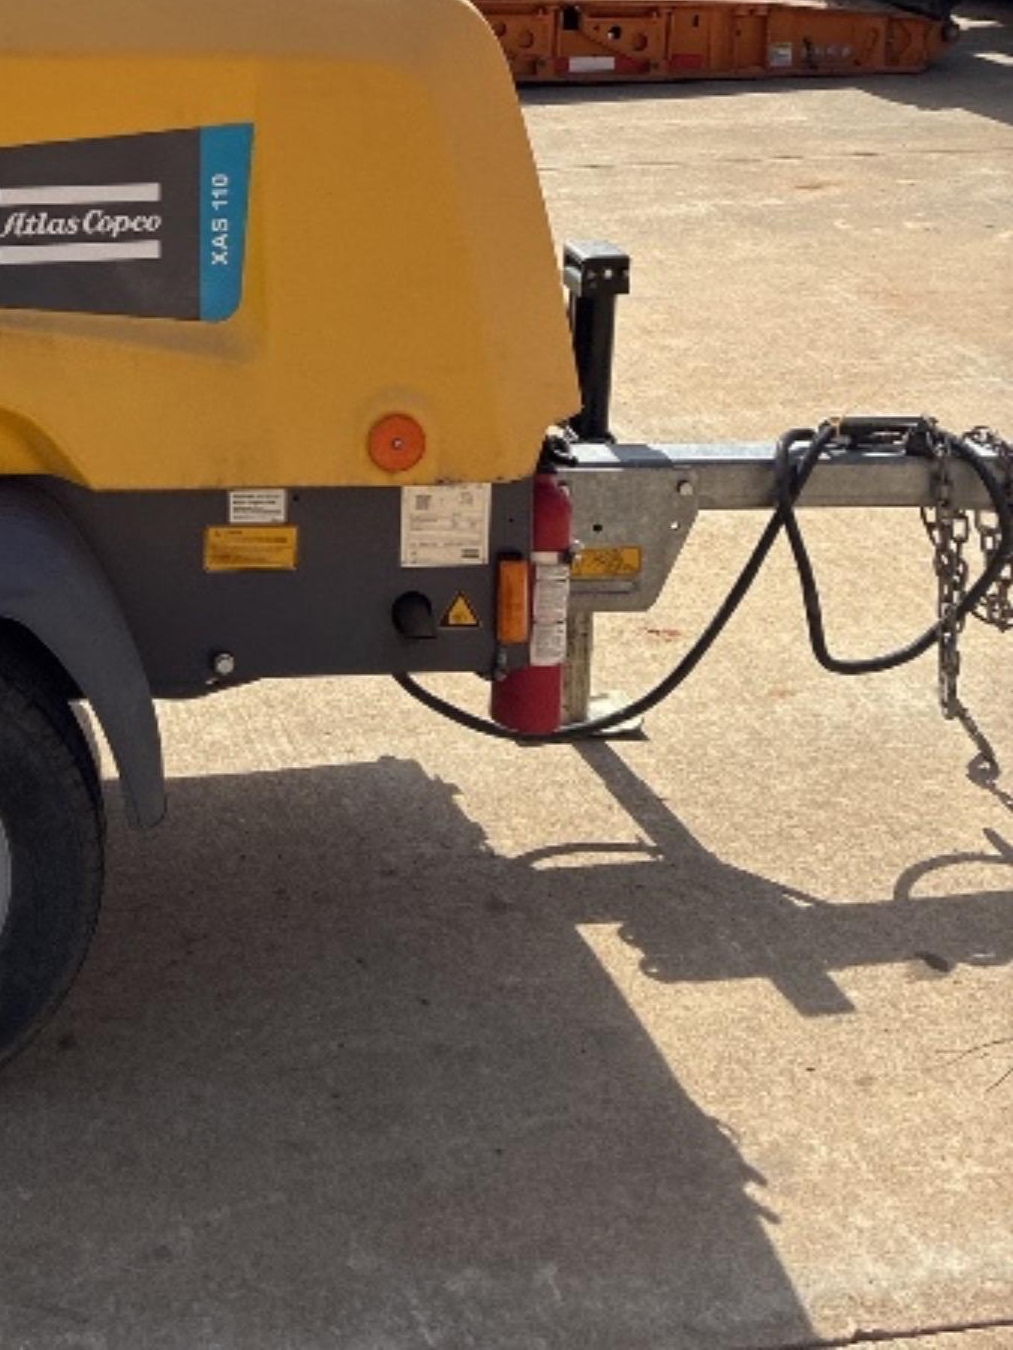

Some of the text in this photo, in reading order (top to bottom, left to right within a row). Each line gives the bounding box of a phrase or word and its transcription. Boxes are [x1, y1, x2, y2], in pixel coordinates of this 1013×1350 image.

[82, 208, 162, 238] Copco
[210, 172, 230, 266] XAS 110
